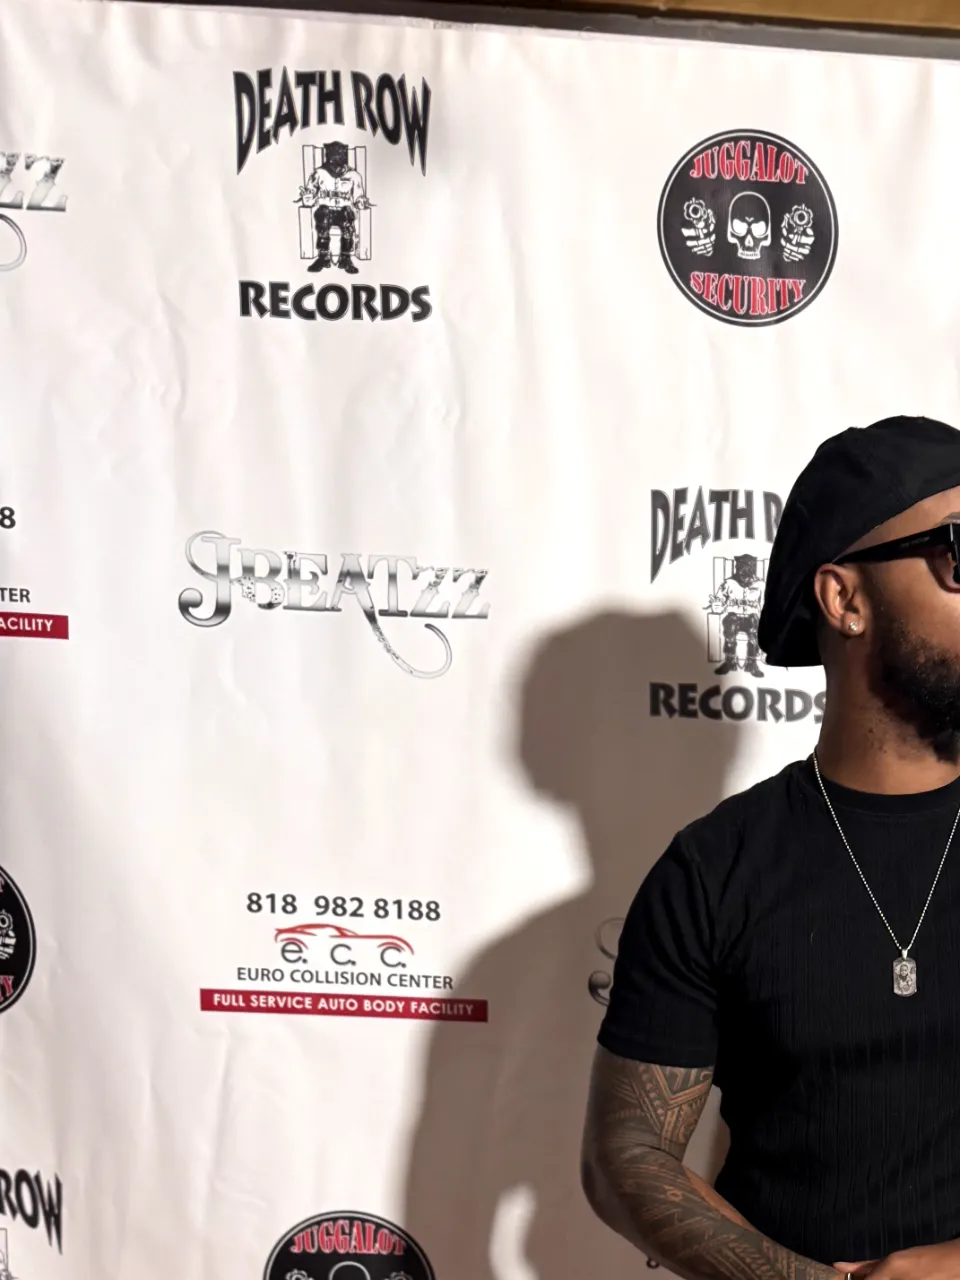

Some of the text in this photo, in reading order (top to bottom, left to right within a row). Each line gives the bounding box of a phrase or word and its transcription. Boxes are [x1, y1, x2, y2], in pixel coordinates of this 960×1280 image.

[233, 65, 431, 177] DEATH ROW
[690, 140, 809, 184] JUGGALOT
[239, 279, 432, 323] RECORDS
[690, 271, 806, 315] SECURITY
[650, 485, 755, 584] DEATH
[0, 587, 31, 603] TER
[178, 530, 490, 679] JBEATZZ
[0, 617, 53, 631] ACILITY
[247, 892, 440, 921] 818 982 8188
[237, 967, 453, 989] EURO COLLISION CENTER
[213, 994, 474, 1016] FULL SERVICE AUTO BODY FACILITY
[290, 1220, 406, 1255] JUGGALOT
